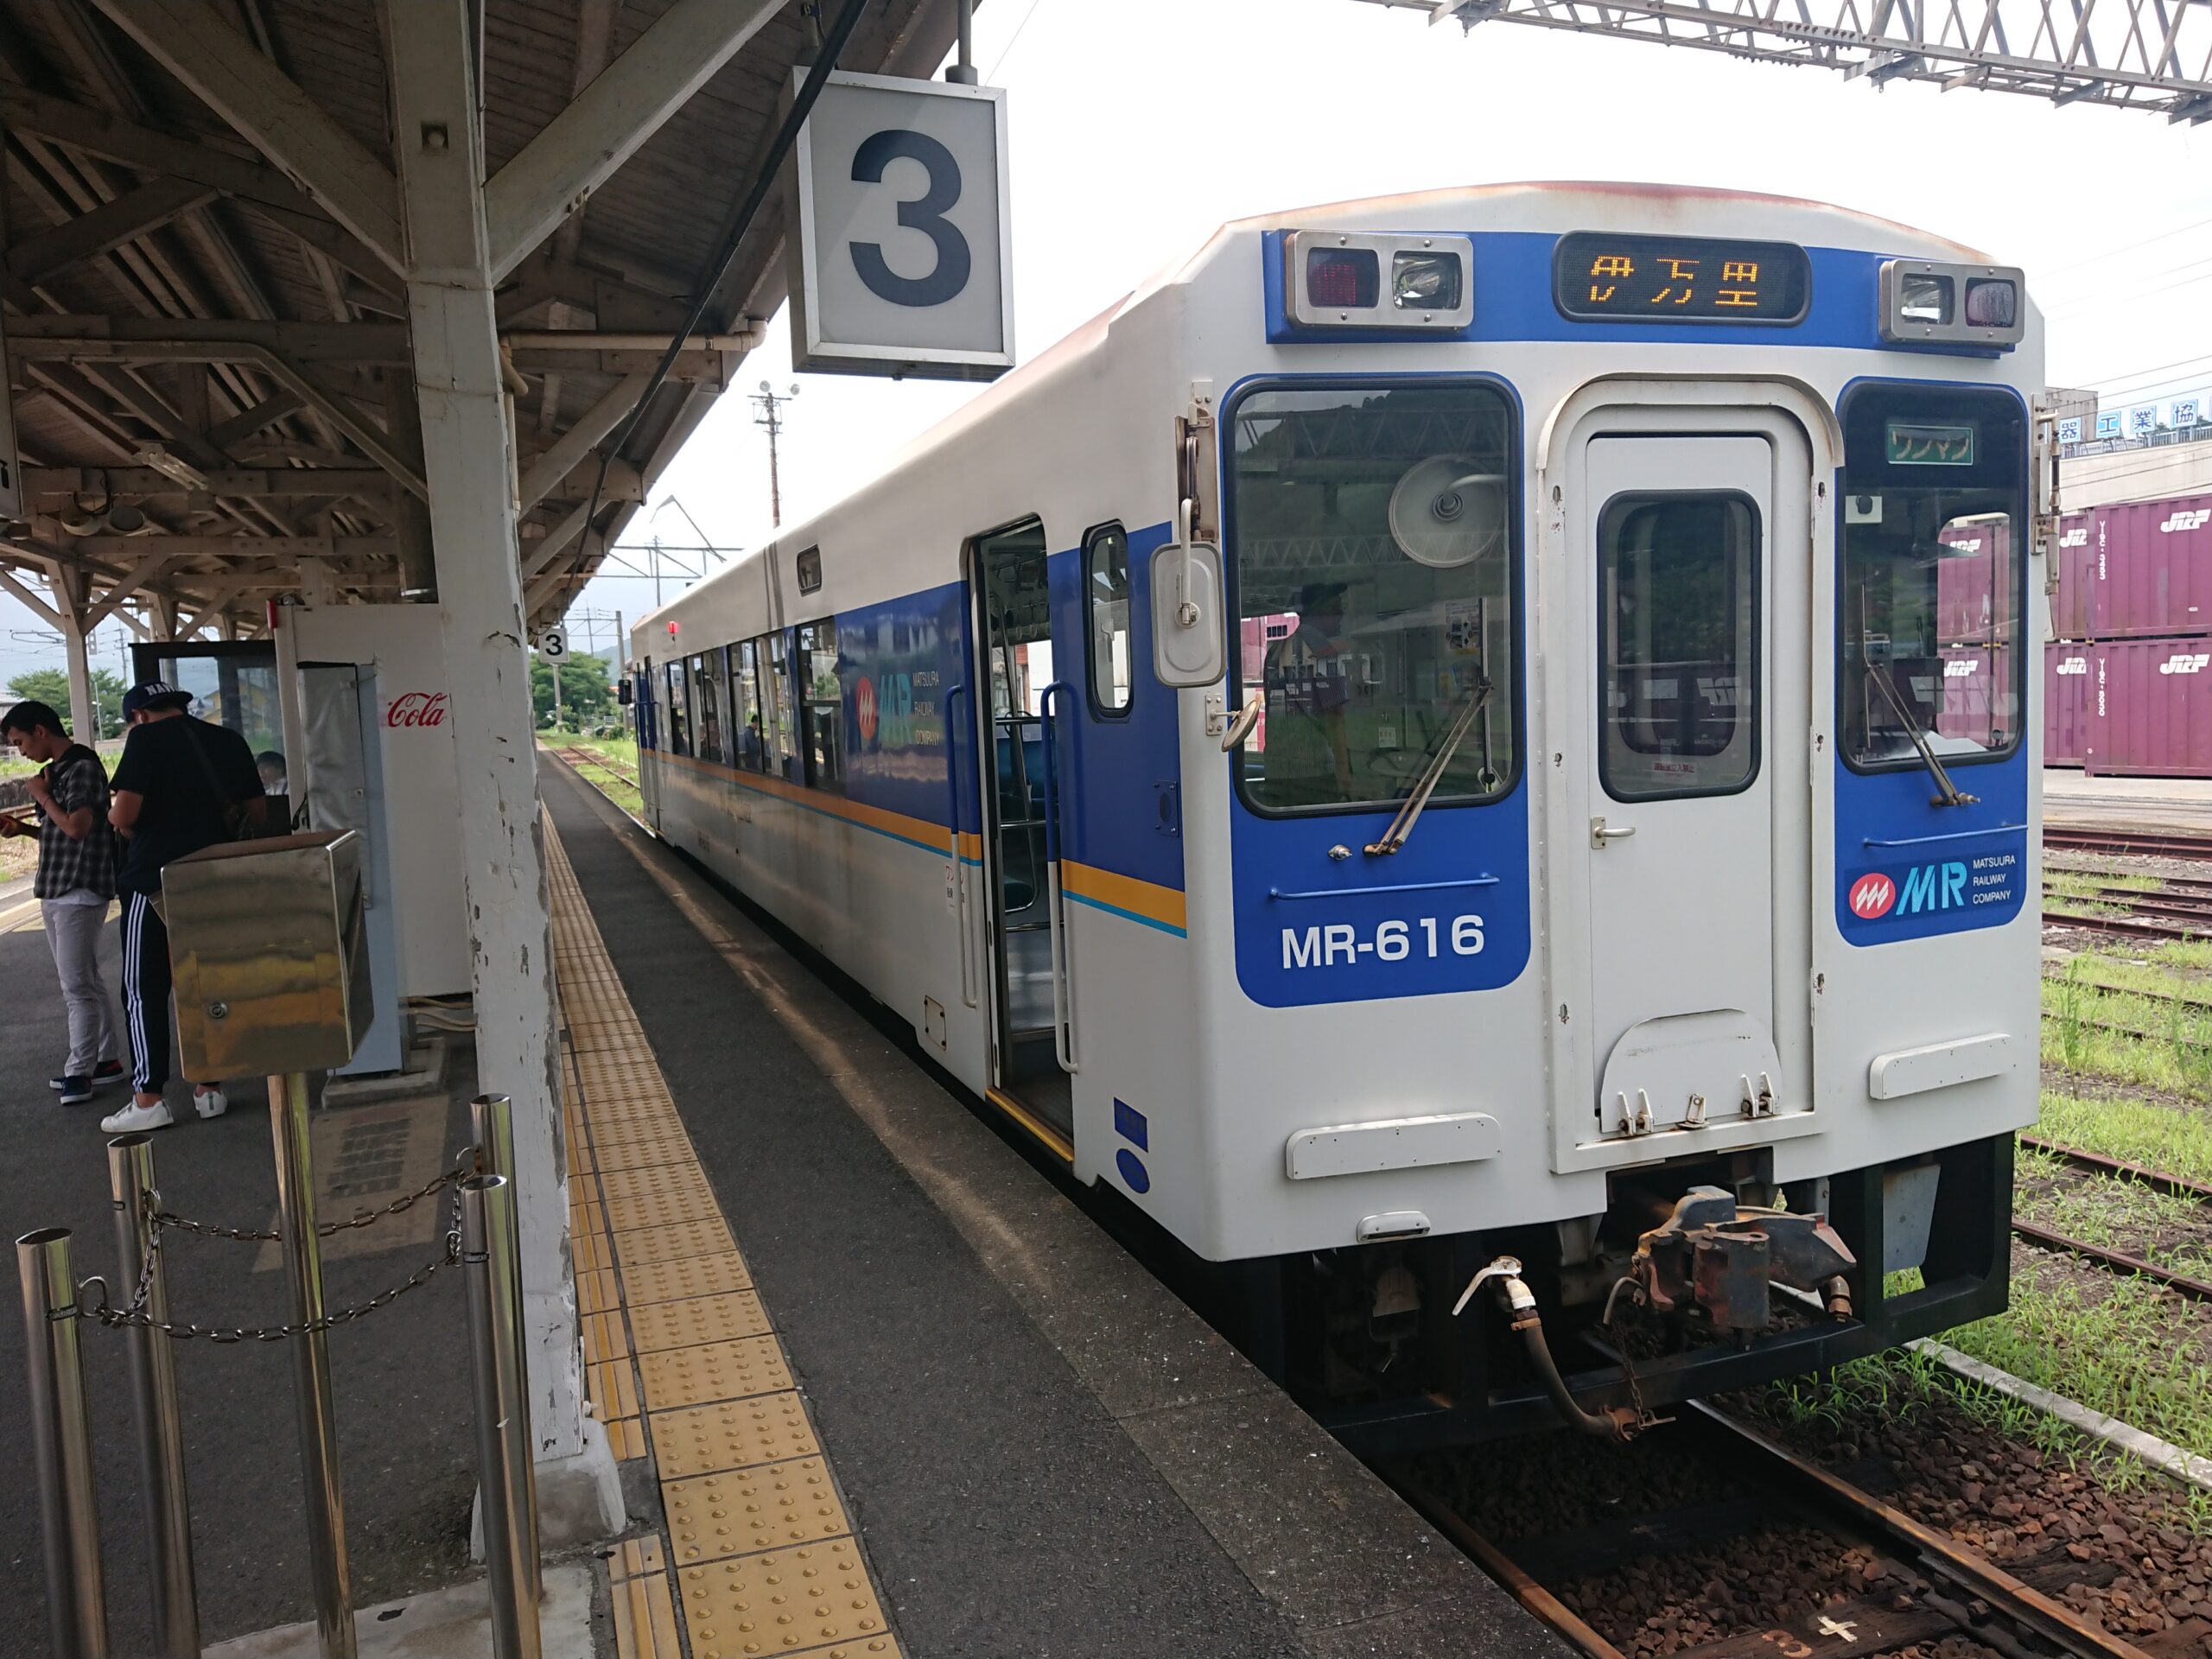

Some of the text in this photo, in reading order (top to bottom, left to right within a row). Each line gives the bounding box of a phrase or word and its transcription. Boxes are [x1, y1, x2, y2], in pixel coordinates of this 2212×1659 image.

[849, 129, 971, 308] 3
[2160, 508, 2211, 532] JRF
[545, 633, 563, 656] 3
[2159, 654, 2210, 674] JRF
[912, 671, 940, 687] MATSUURA
[388, 692, 448, 728] Cola
[916, 729, 940, 747] COMPANY
[1973, 855, 2016, 869] MATSUURA
[1896, 861, 1967, 916] MR
[1973, 873, 2006, 887] RAILWAY
[1973, 890, 2012, 905] COMPANY
[1281, 914, 1484, 969] MR-616
